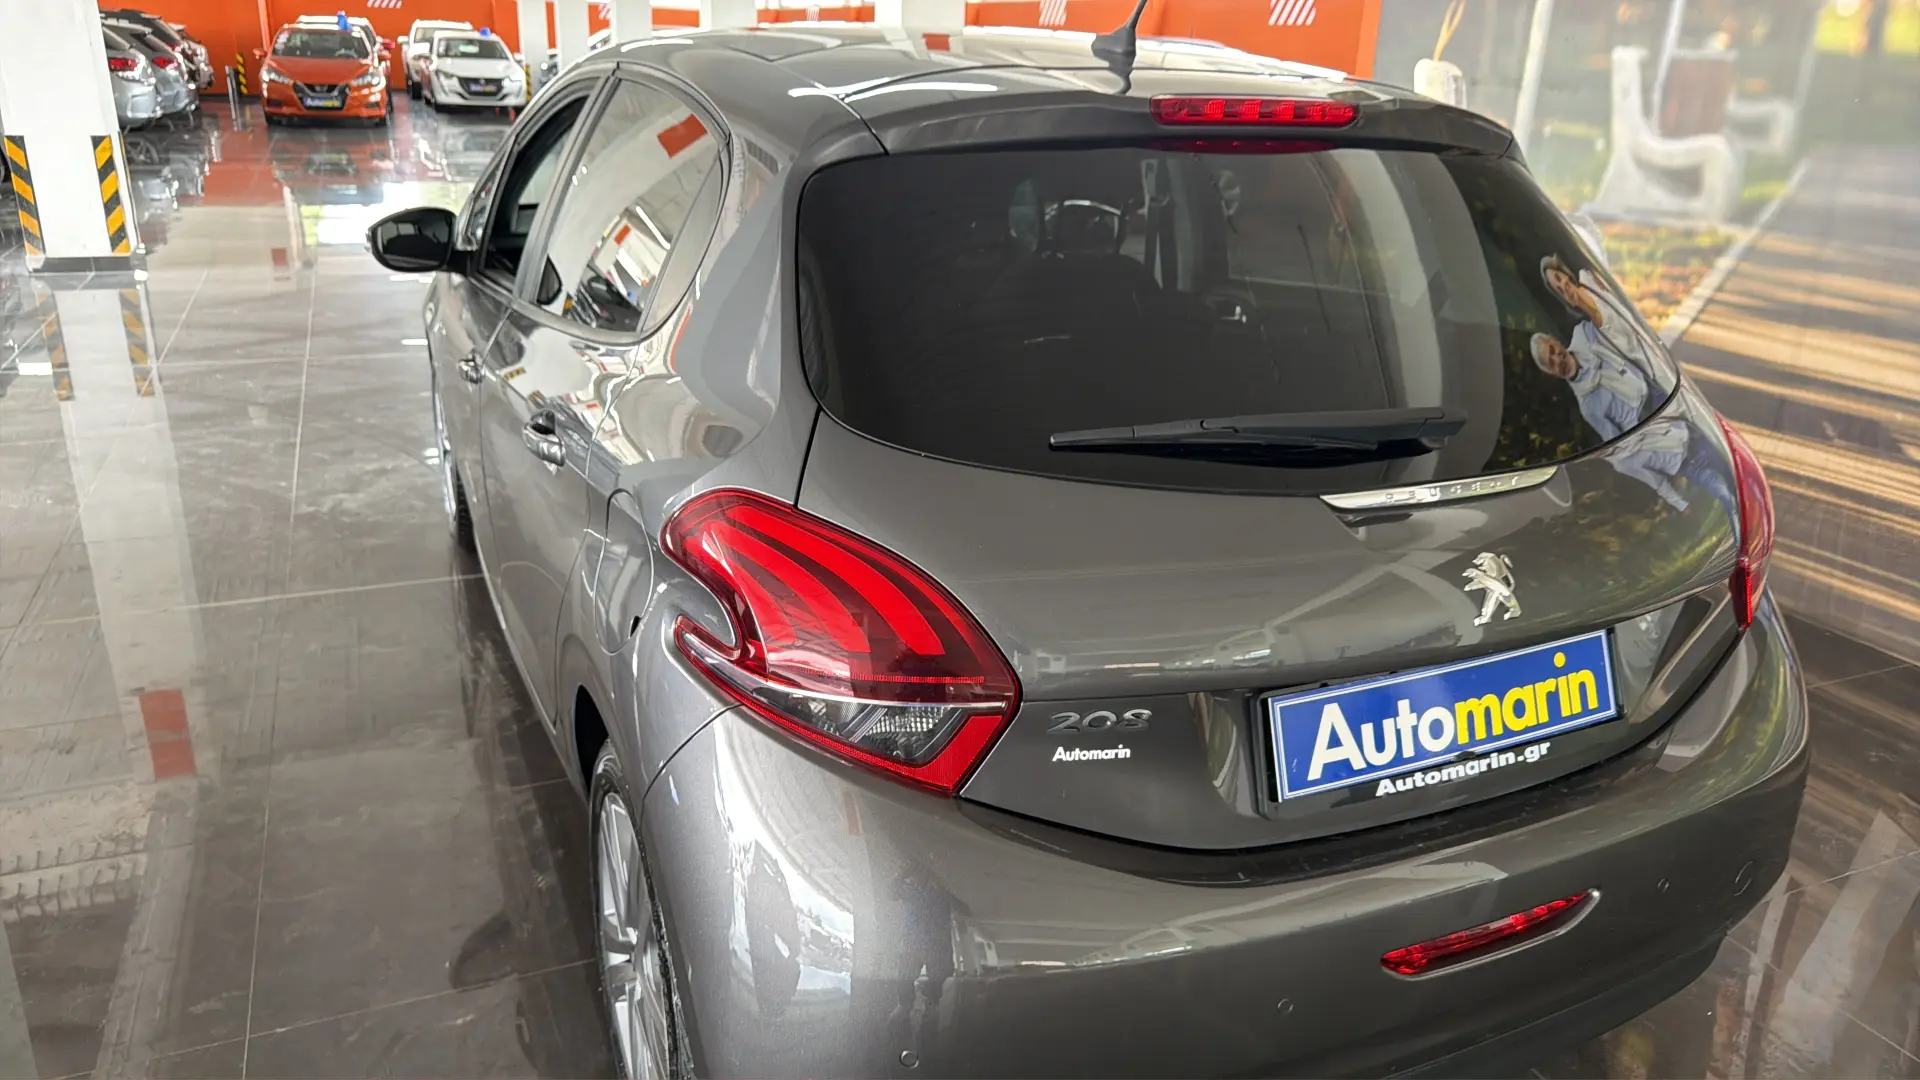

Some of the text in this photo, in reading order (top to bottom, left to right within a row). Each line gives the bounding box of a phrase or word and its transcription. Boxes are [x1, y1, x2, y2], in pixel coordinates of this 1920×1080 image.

[1046, 708, 1153, 734] 208
[1306, 651, 1599, 781] Automarin
[1051, 744, 1131, 762] Automarin
[1375, 741, 1551, 797] Automarin.gr
